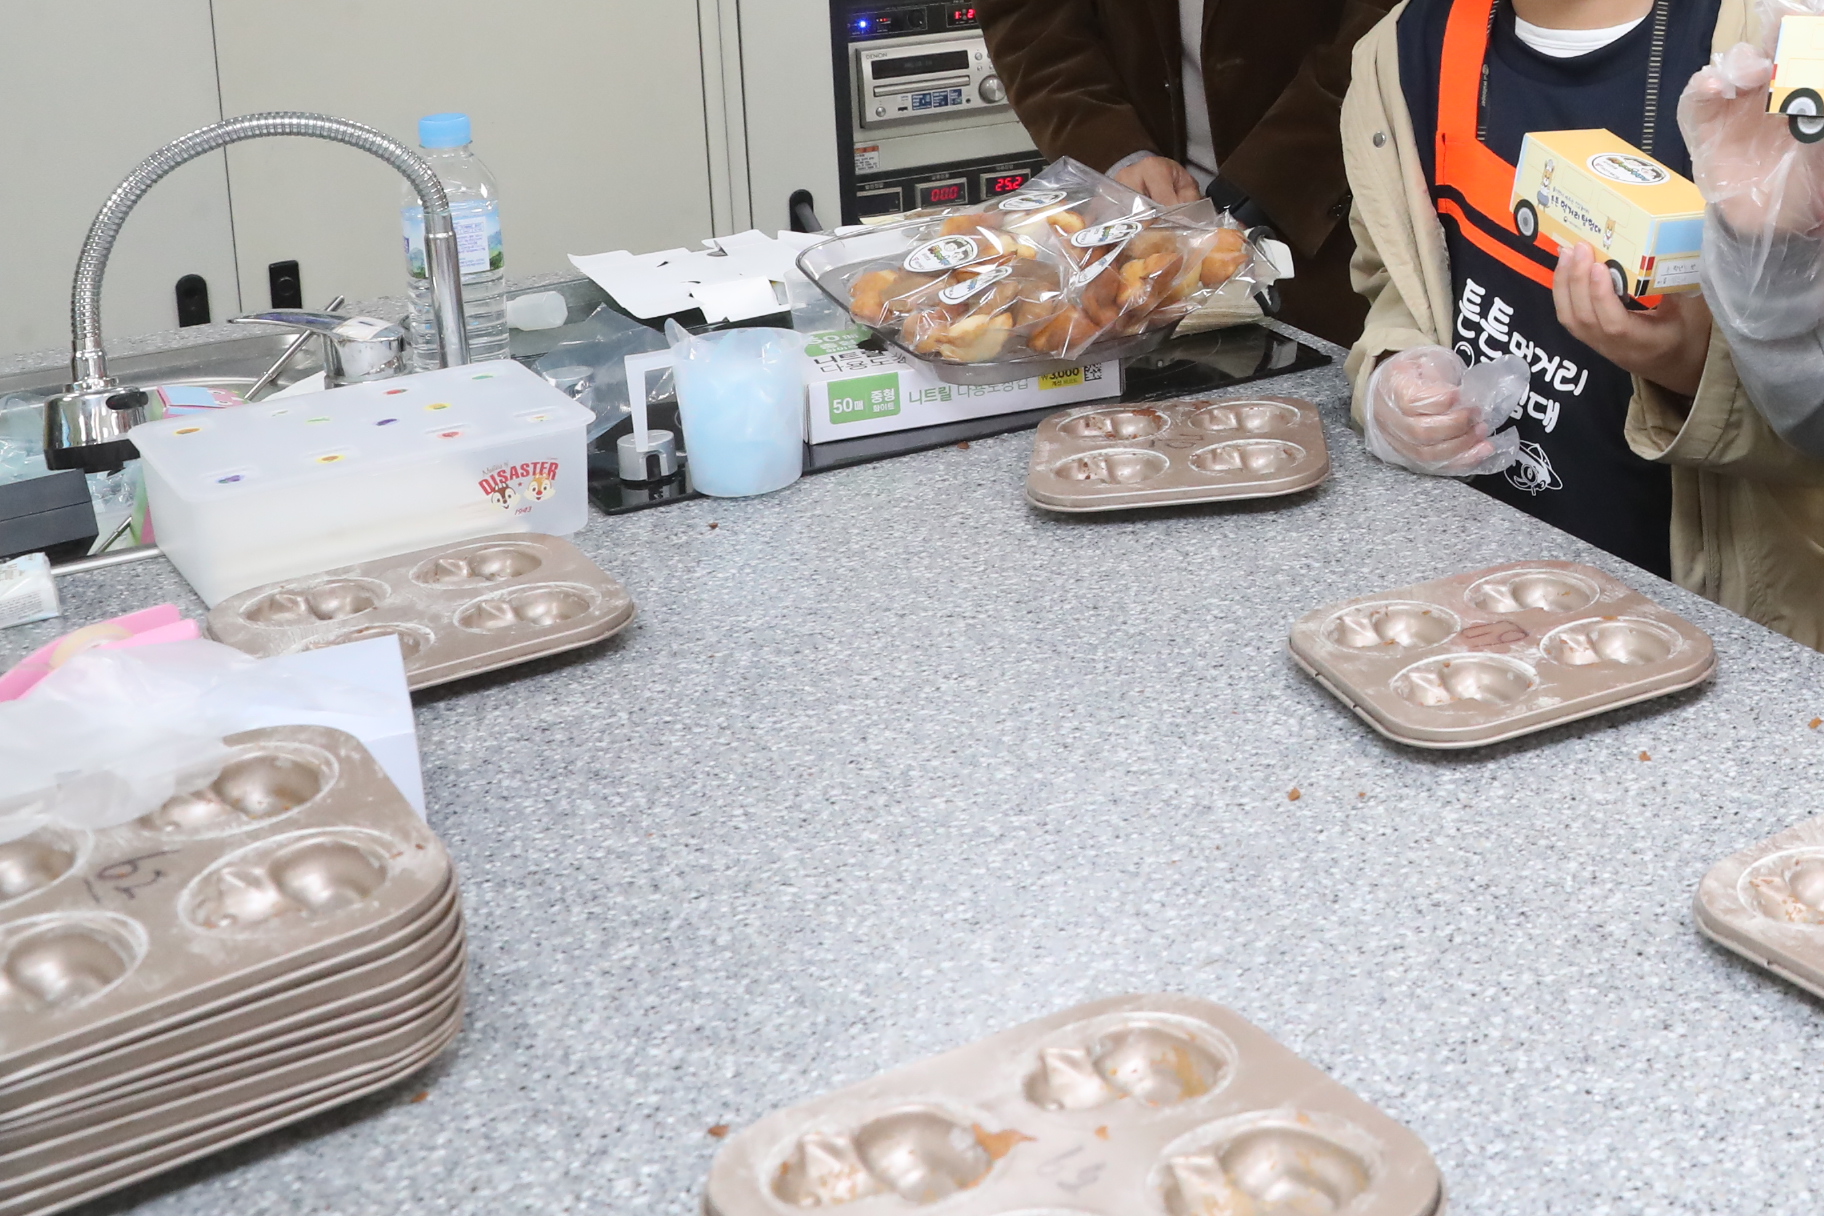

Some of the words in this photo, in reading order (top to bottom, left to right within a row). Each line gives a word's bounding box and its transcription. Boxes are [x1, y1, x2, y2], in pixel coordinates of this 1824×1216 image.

[1457, 278, 1514, 358] 튼튼
[871, 388, 895, 403] 중형
[909, 386, 952, 405] 니트릴
[833, 397, 864, 414] 50매
[873, 403, 895, 412] 화이트
[478, 462, 559, 496] DISASTER
